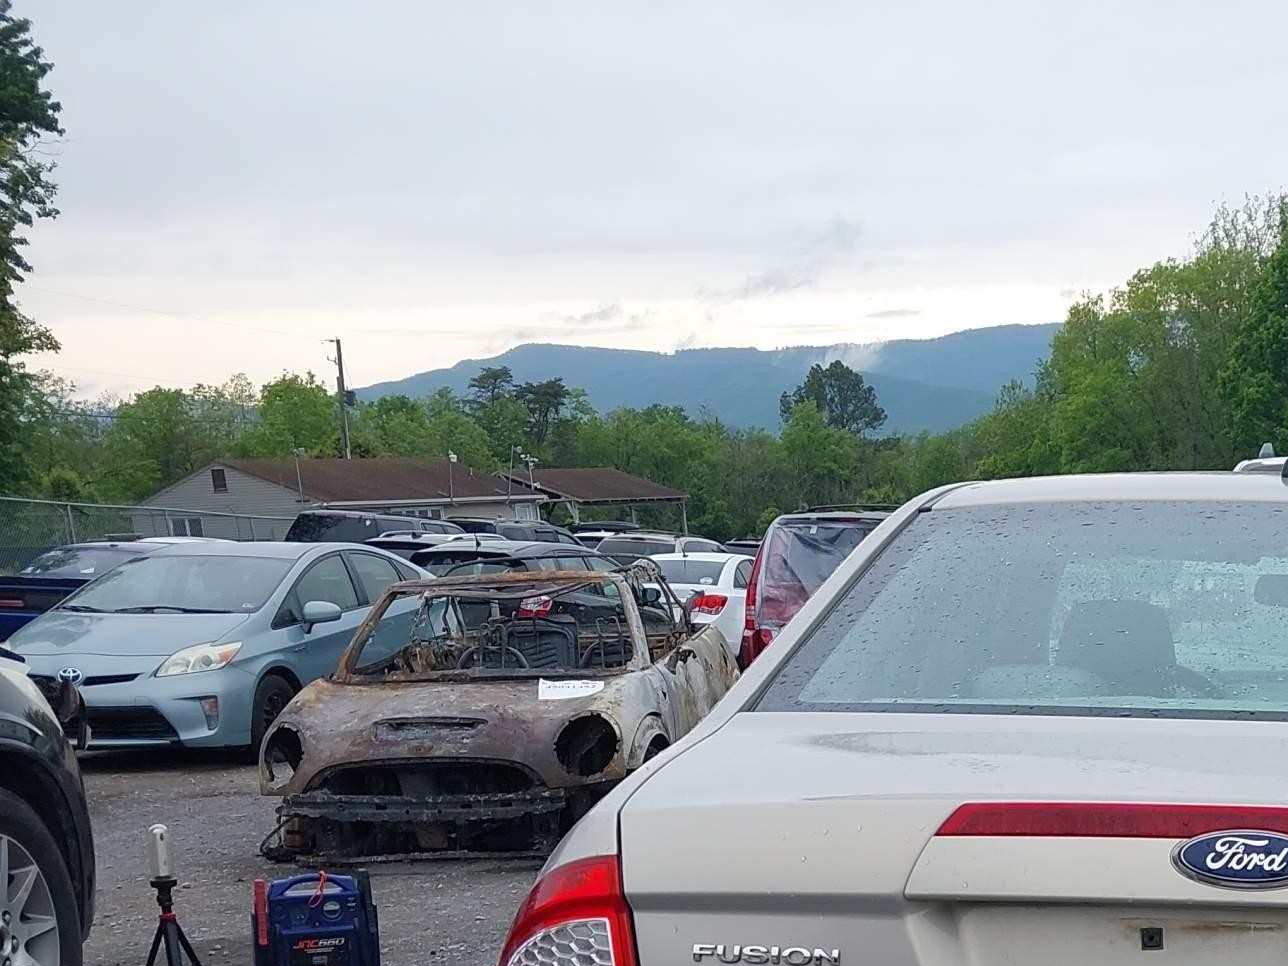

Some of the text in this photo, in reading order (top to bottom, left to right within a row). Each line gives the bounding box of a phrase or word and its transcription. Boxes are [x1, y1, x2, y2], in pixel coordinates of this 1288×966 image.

[1206, 837, 1288, 871] Ford
[293, 937, 344, 949] JNC660
[692, 943, 841, 966] FUSION
